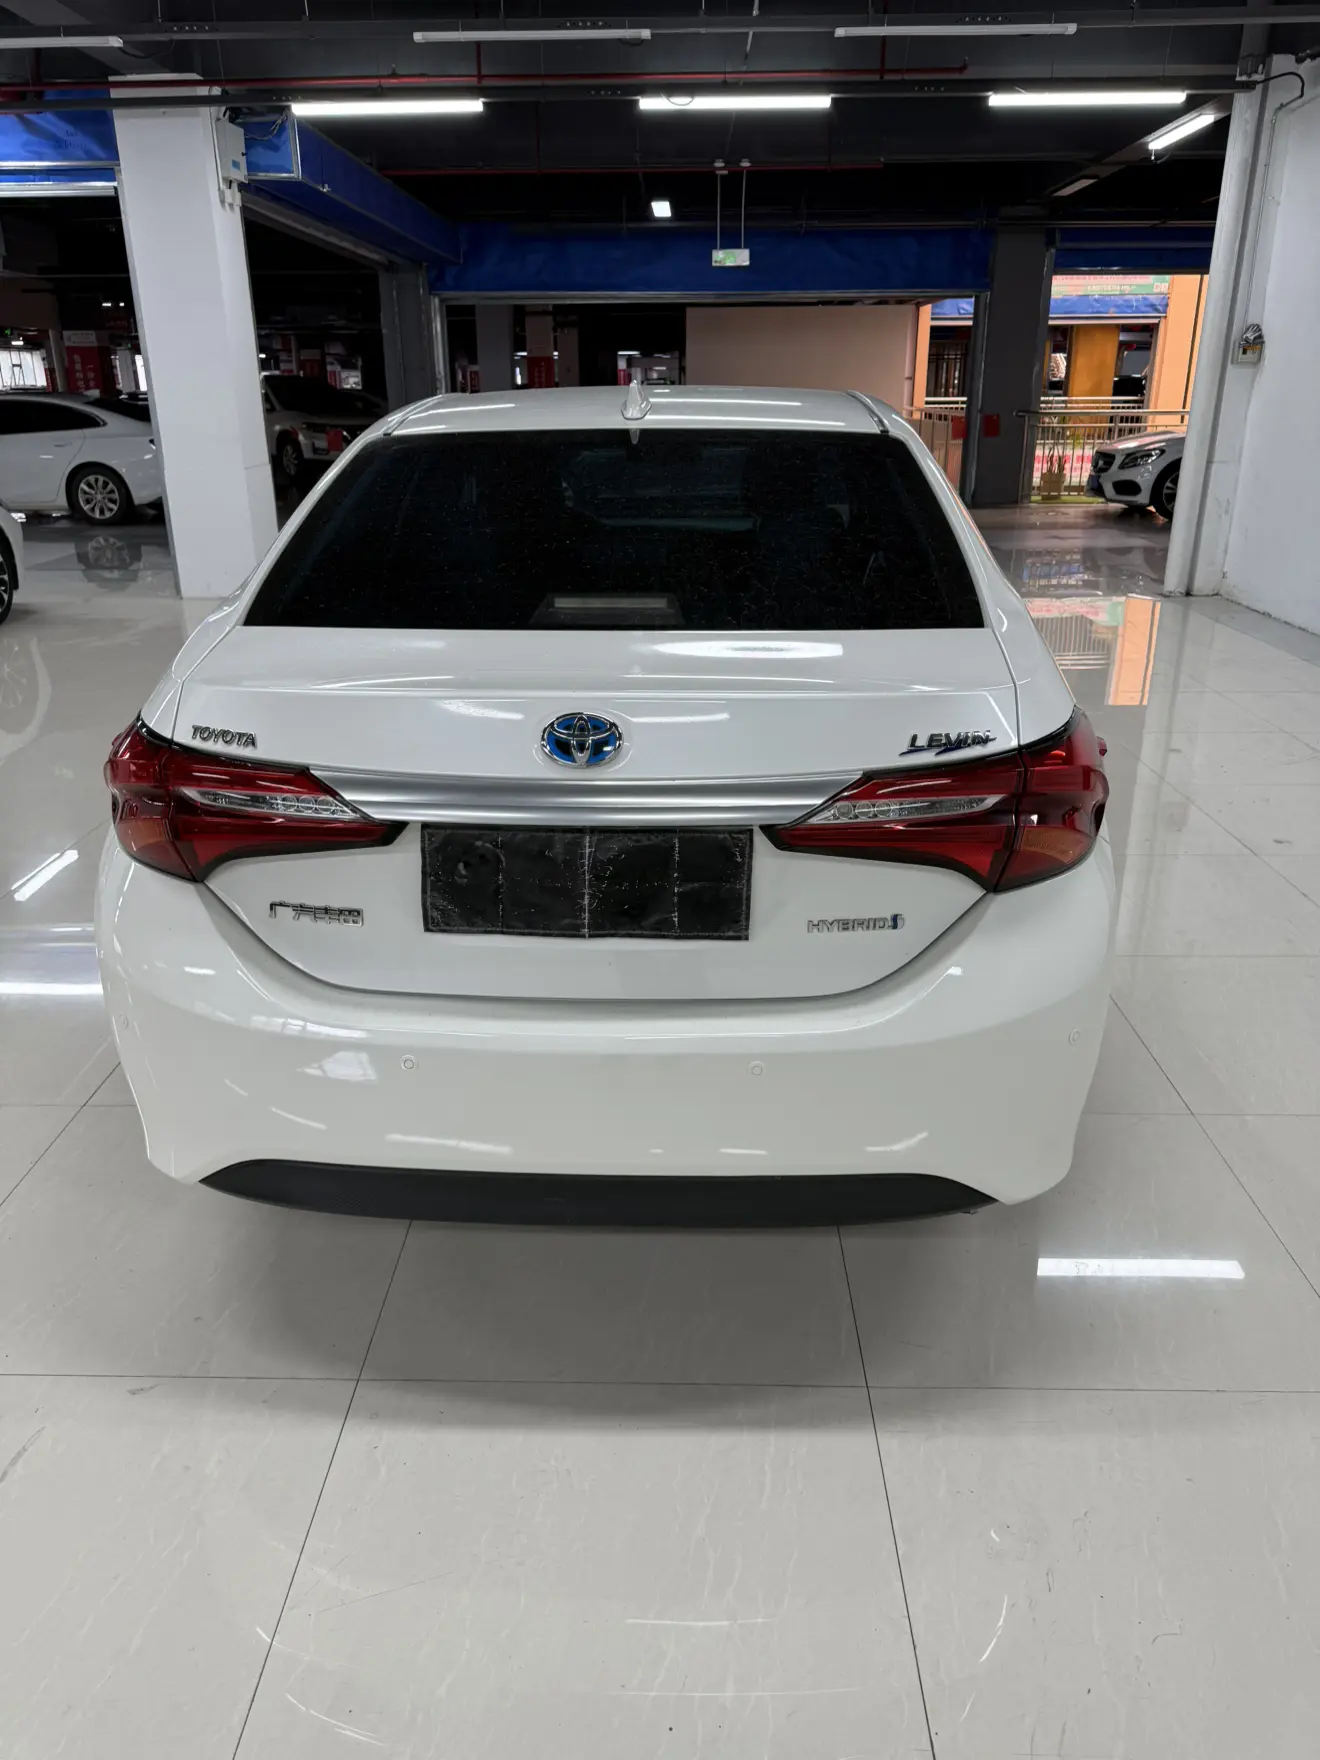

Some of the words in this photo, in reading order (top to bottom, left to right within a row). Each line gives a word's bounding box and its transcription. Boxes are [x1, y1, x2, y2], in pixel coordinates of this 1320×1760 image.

[191, 724, 257, 749] TOYOTA
[903, 729, 995, 752] LEVIN
[807, 917, 889, 933] HYBRID
